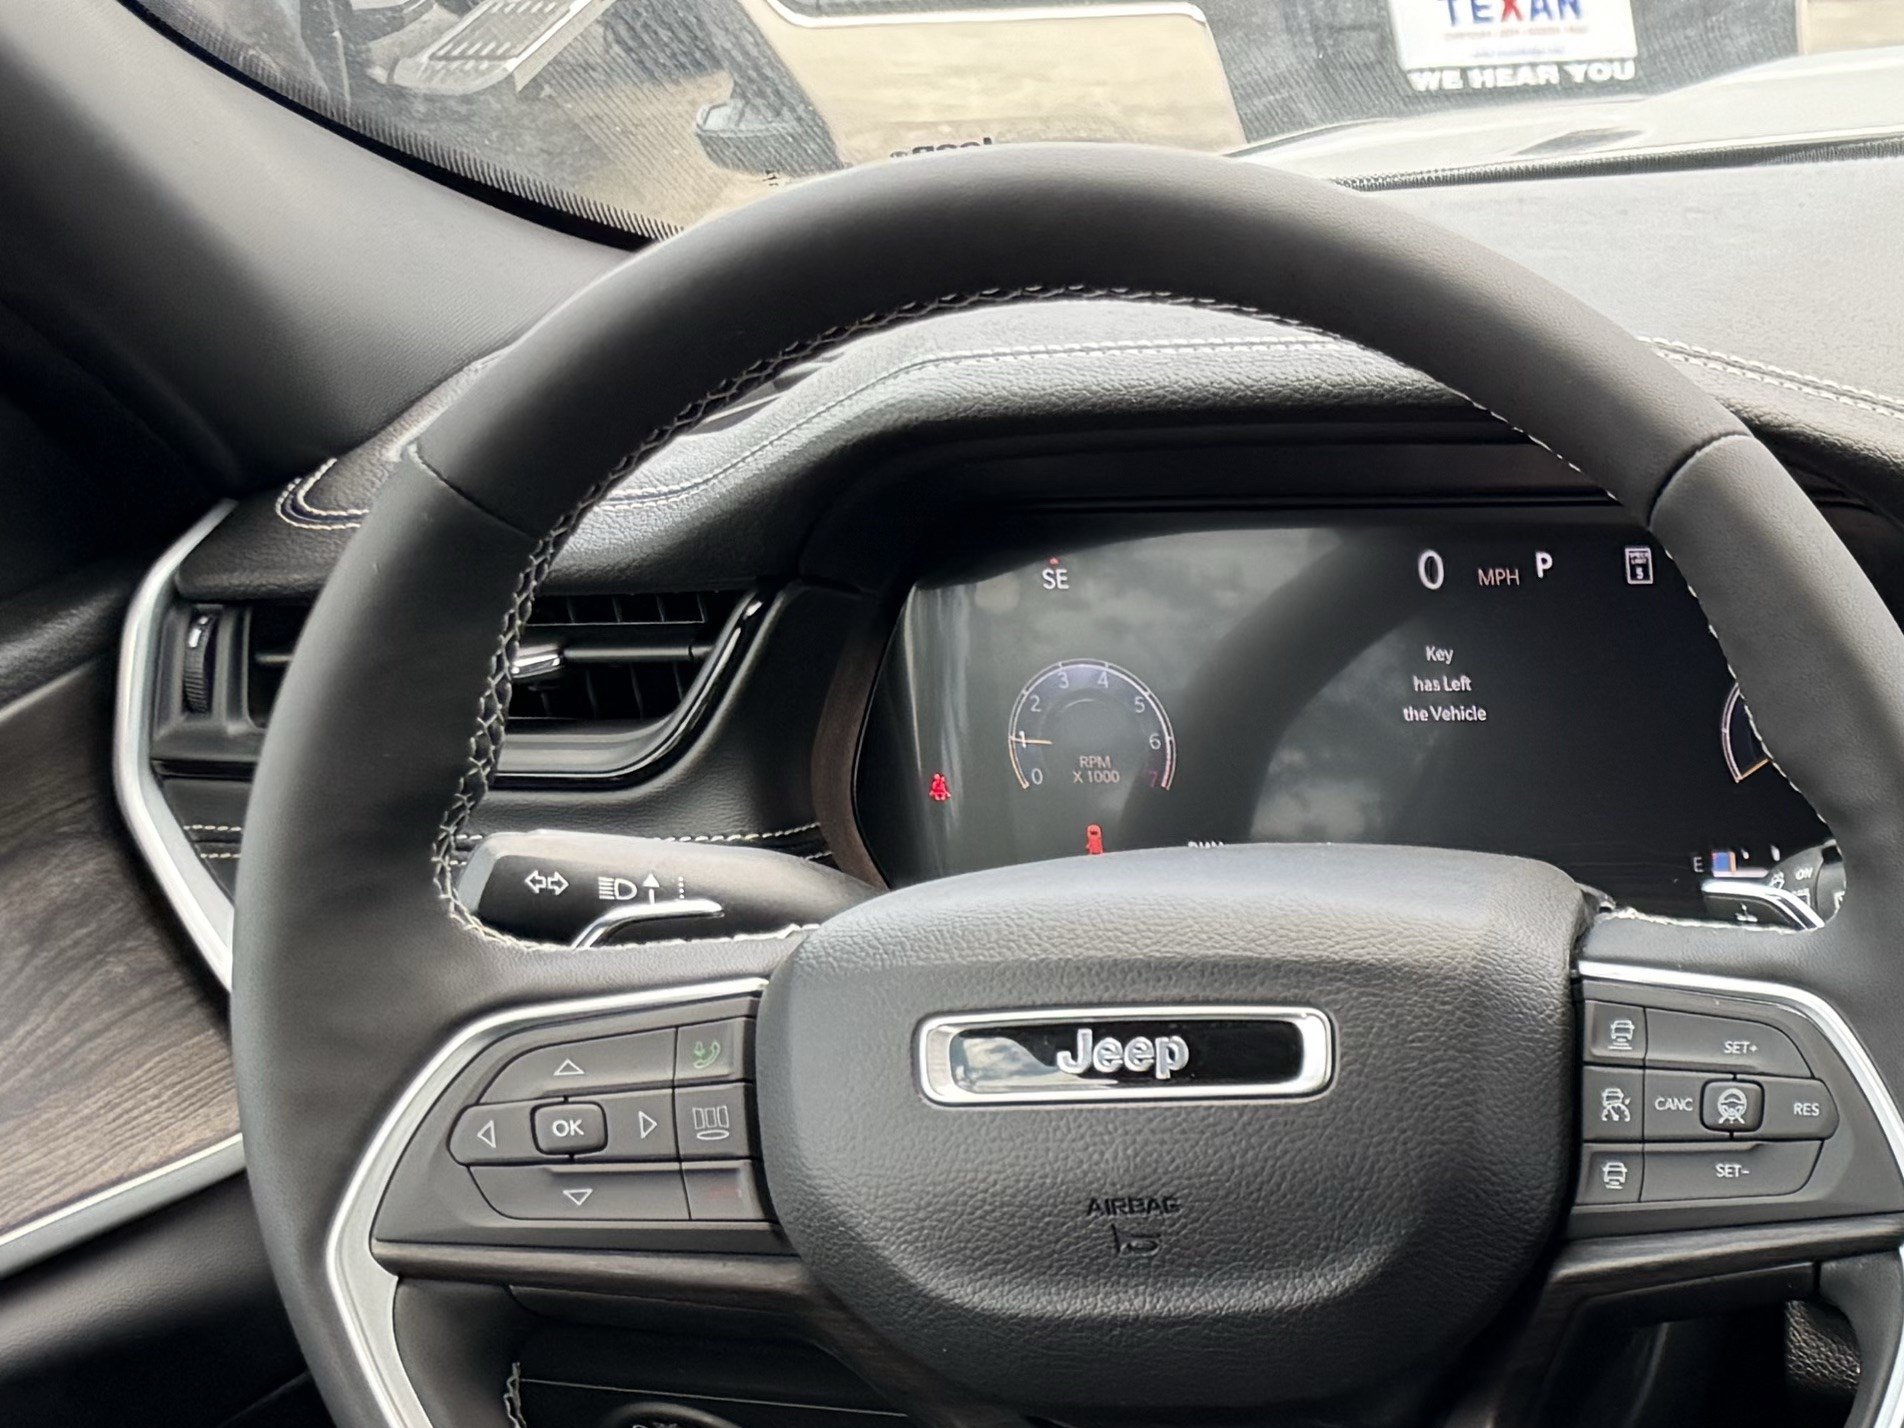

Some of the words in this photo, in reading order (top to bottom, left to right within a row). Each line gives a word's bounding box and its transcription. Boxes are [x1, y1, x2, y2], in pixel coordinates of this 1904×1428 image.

[1408, 70, 1463, 91] WE
[1564, 60, 1635, 83] YOU
[1536, 551, 1553, 578] P
[1042, 568, 1069, 590] SE
[1477, 568, 1521, 586] MPH
[1426, 646, 1453, 664] Key
[1058, 672, 1069, 688] 3
[1098, 671, 1109, 688] 4
[1413, 676, 1440, 692] has
[1444, 675, 1472, 691] Left
[1030, 695, 1042, 712] 2
[1134, 696, 1146, 713] 5
[1403, 706, 1428, 721] the
[1431, 705, 1487, 721] Vehicle
[1149, 733, 1161, 750] 6
[1079, 756, 1111, 768] RPM
[1031, 768, 1043, 785] 0
[1088, 771, 1120, 783] 1000
[1693, 857, 1704, 872] E
[1056, 1028, 1190, 1080] Jeep
[1655, 1096, 1693, 1111] CANC
[1793, 1103, 1820, 1117] RES
[552, 1119, 585, 1137] OK
[1086, 1197, 1181, 1216] AIRBAG
